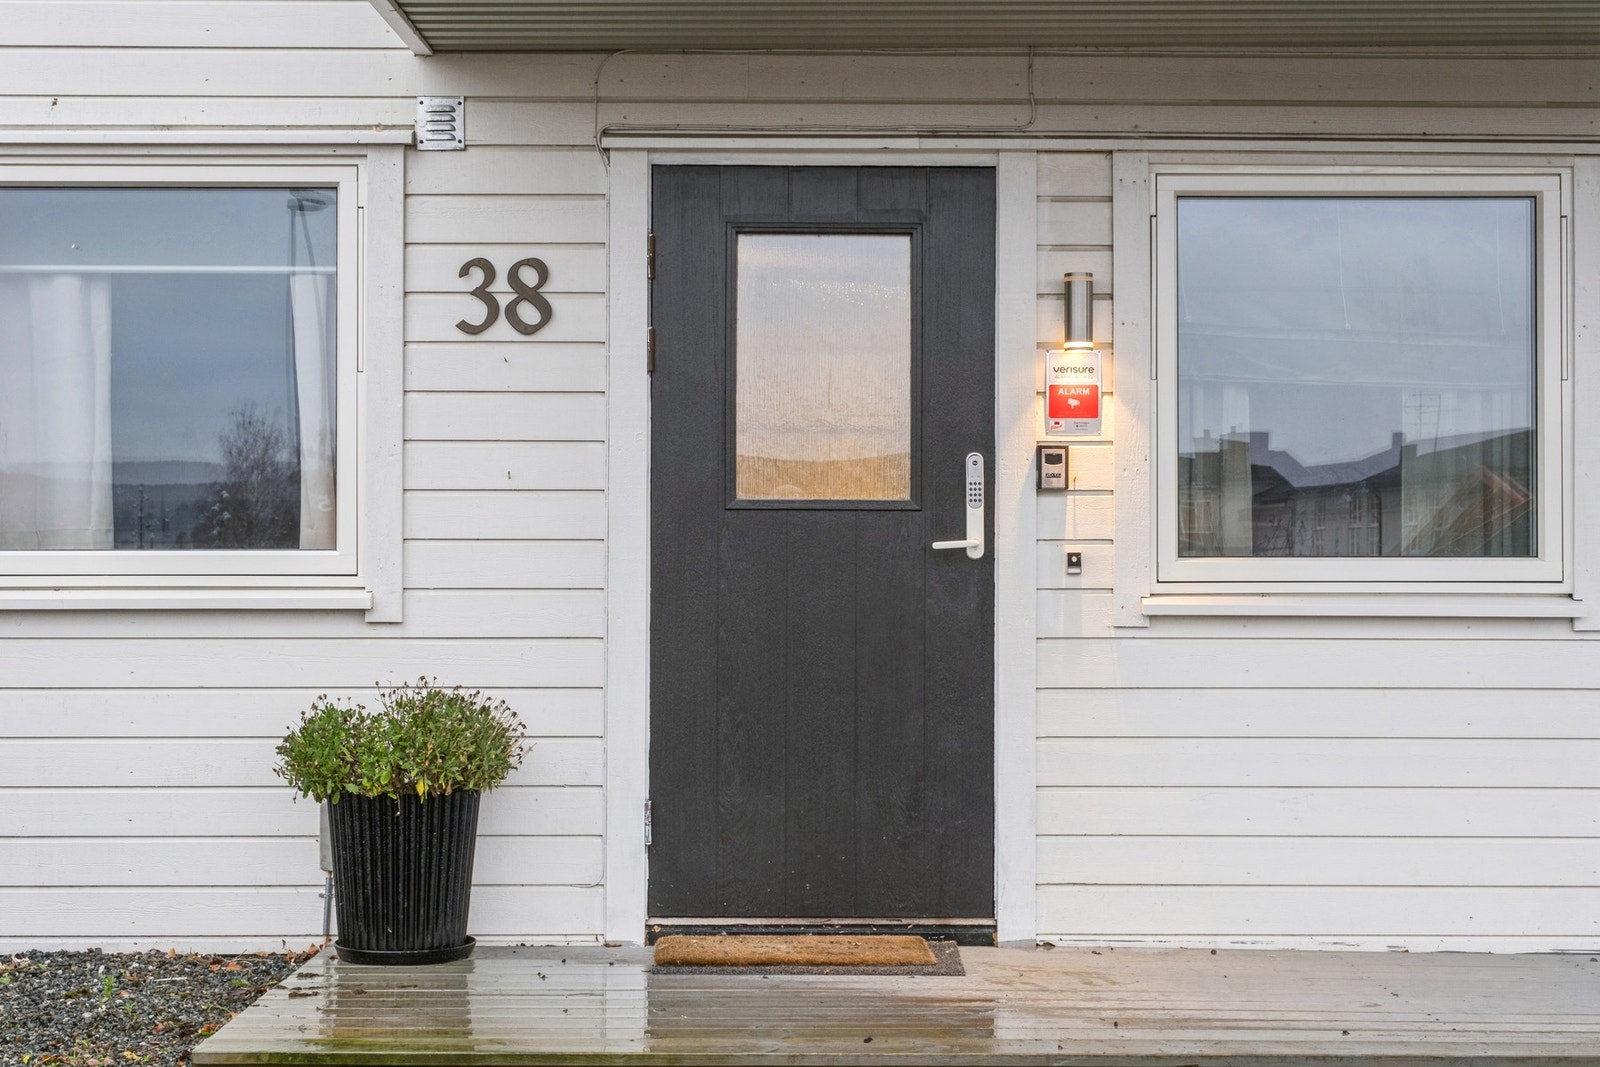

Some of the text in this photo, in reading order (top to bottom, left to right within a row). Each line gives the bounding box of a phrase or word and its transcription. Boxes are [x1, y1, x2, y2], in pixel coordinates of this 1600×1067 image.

[456, 257, 552, 335] 38
[1053, 366, 1095, 374] verisure
[1057, 387, 1090, 396] ALARM
